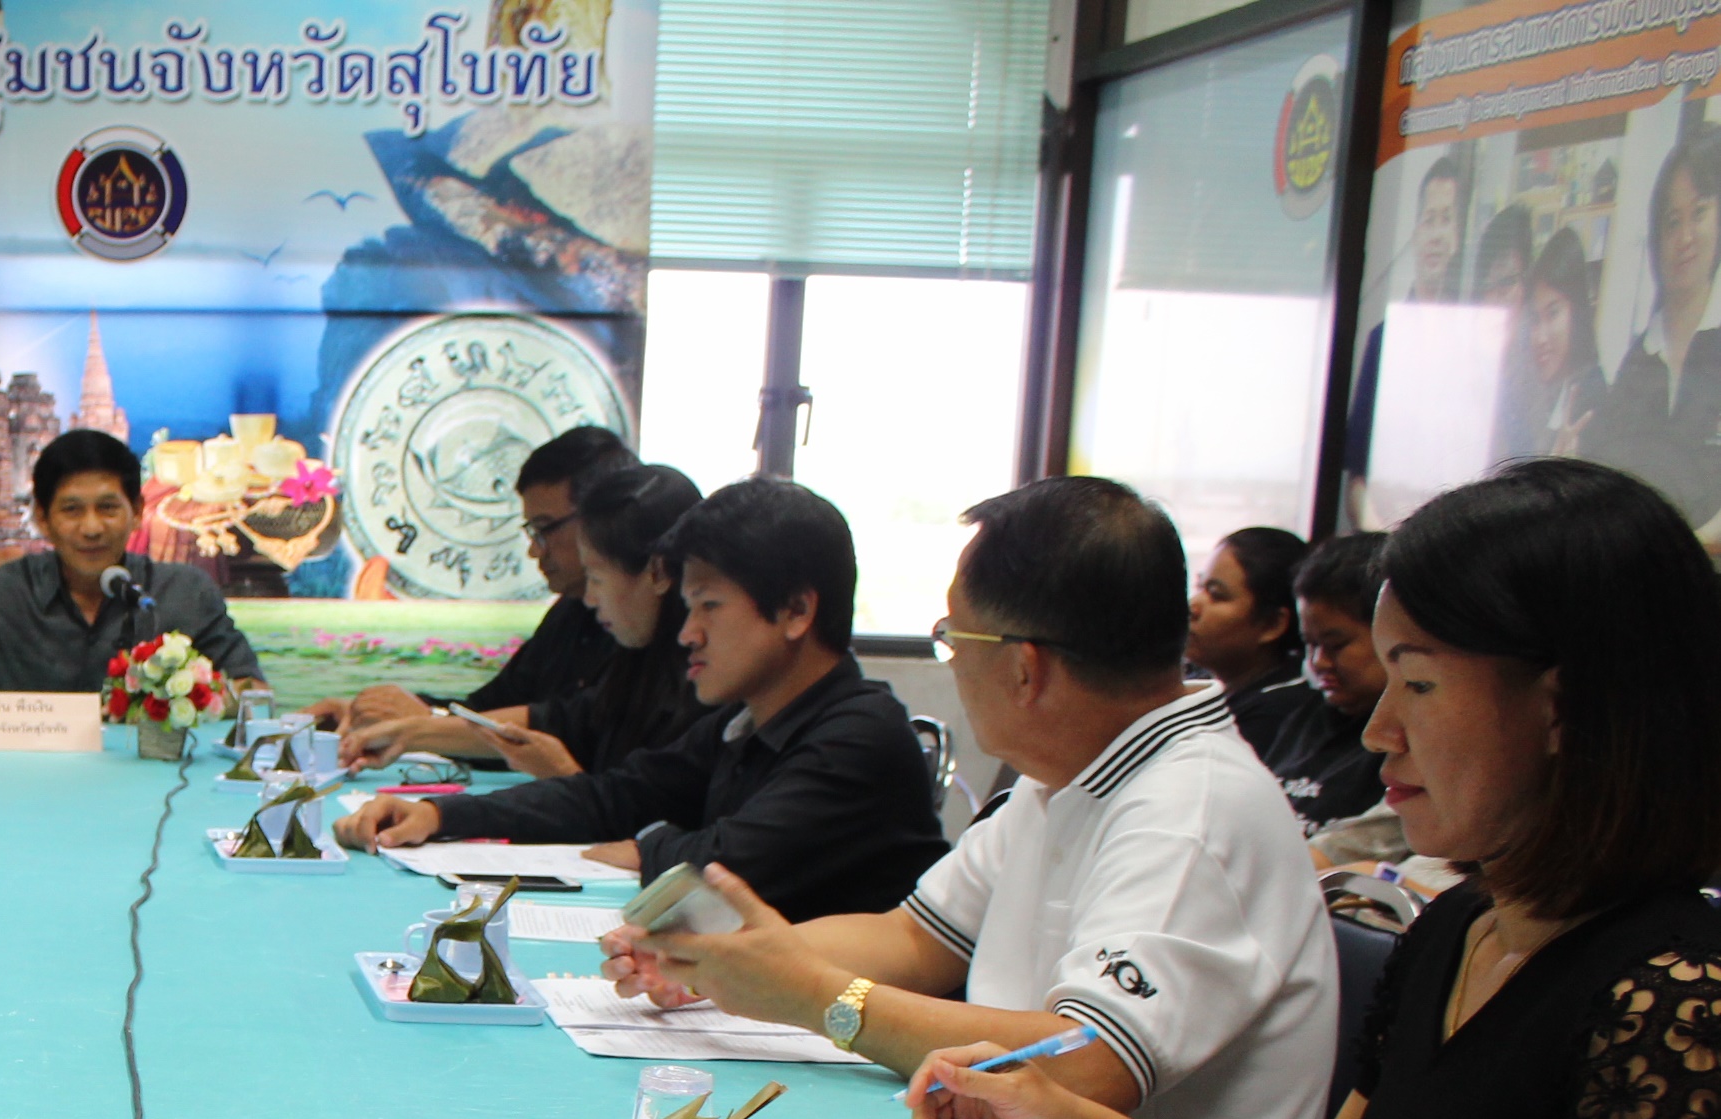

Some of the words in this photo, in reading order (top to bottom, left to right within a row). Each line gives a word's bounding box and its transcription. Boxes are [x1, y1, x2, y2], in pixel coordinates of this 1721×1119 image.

[1400, 94, 1471, 136] Community
[1473, 80, 1566, 121] Development
[1569, 57, 1657, 103] Information
[1661, 49, 1719, 87] Group
